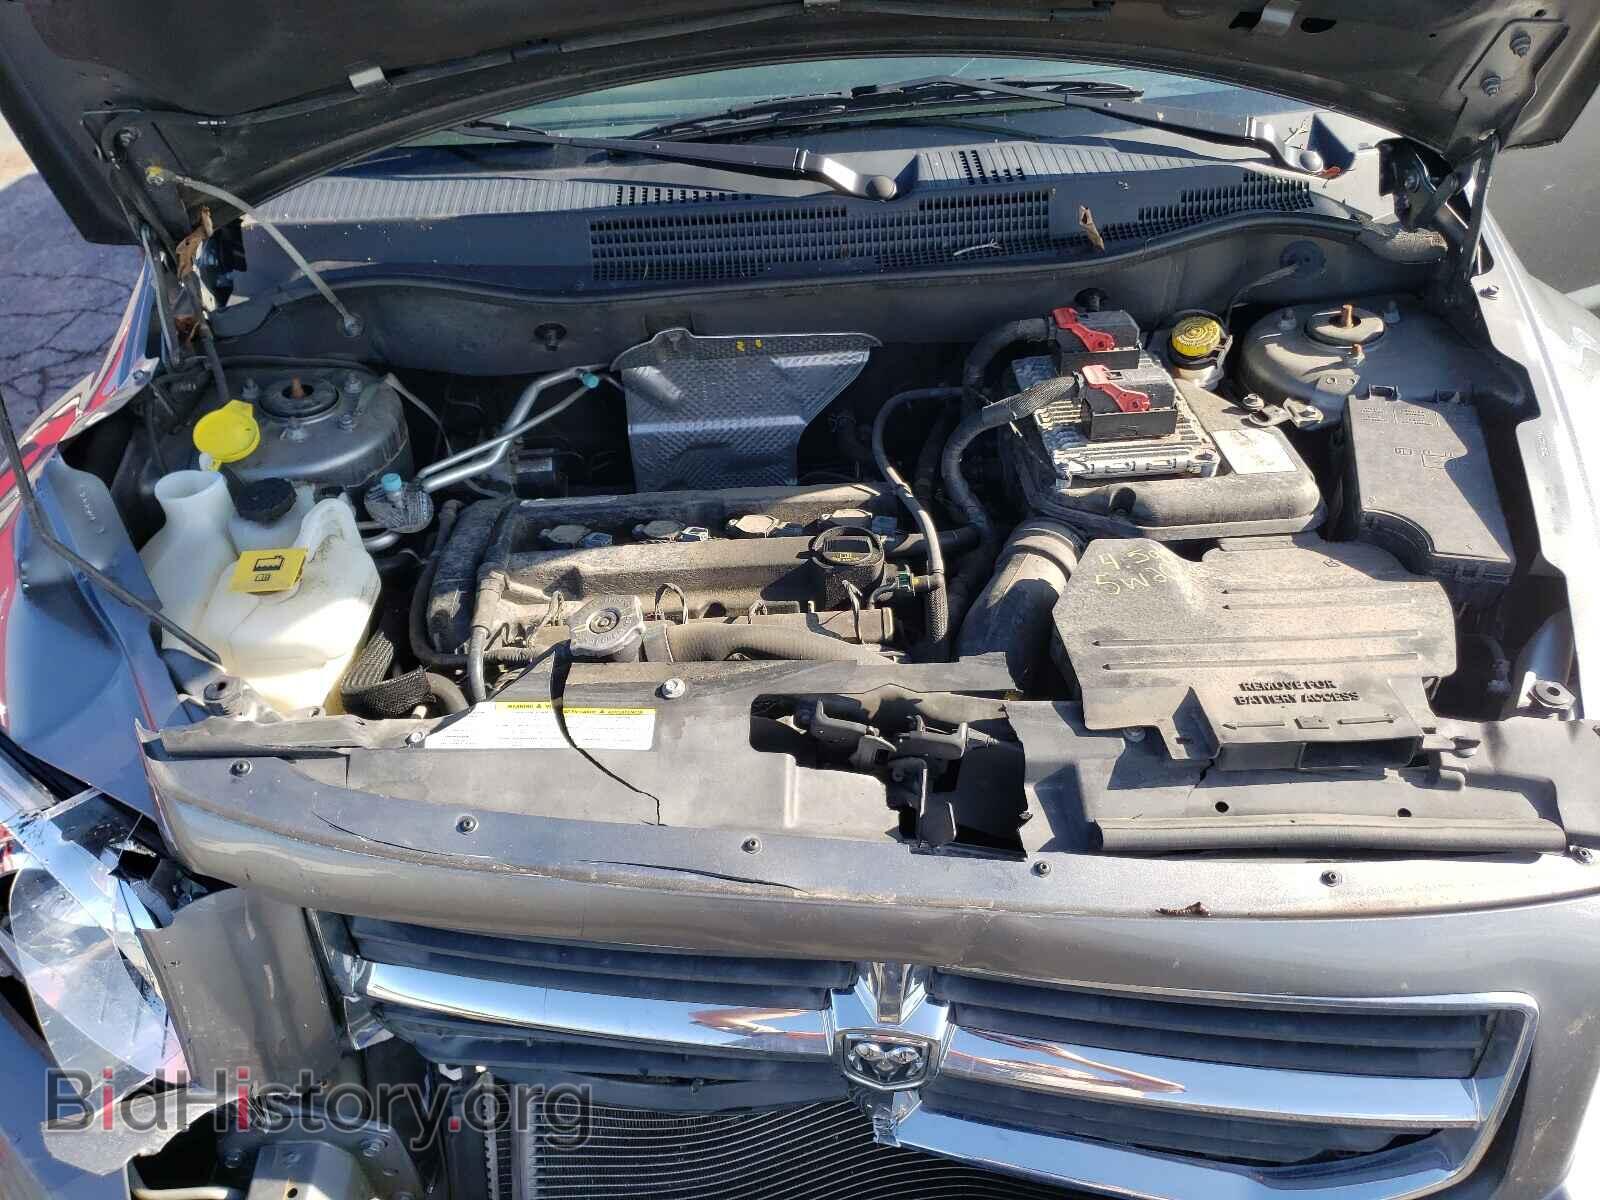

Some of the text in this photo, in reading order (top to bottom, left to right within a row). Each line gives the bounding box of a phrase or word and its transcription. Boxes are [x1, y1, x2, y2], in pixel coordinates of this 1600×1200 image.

[1238, 680, 1337, 691] REMOVE FOR
[1233, 692, 1360, 706] BATTERY ACCESS
